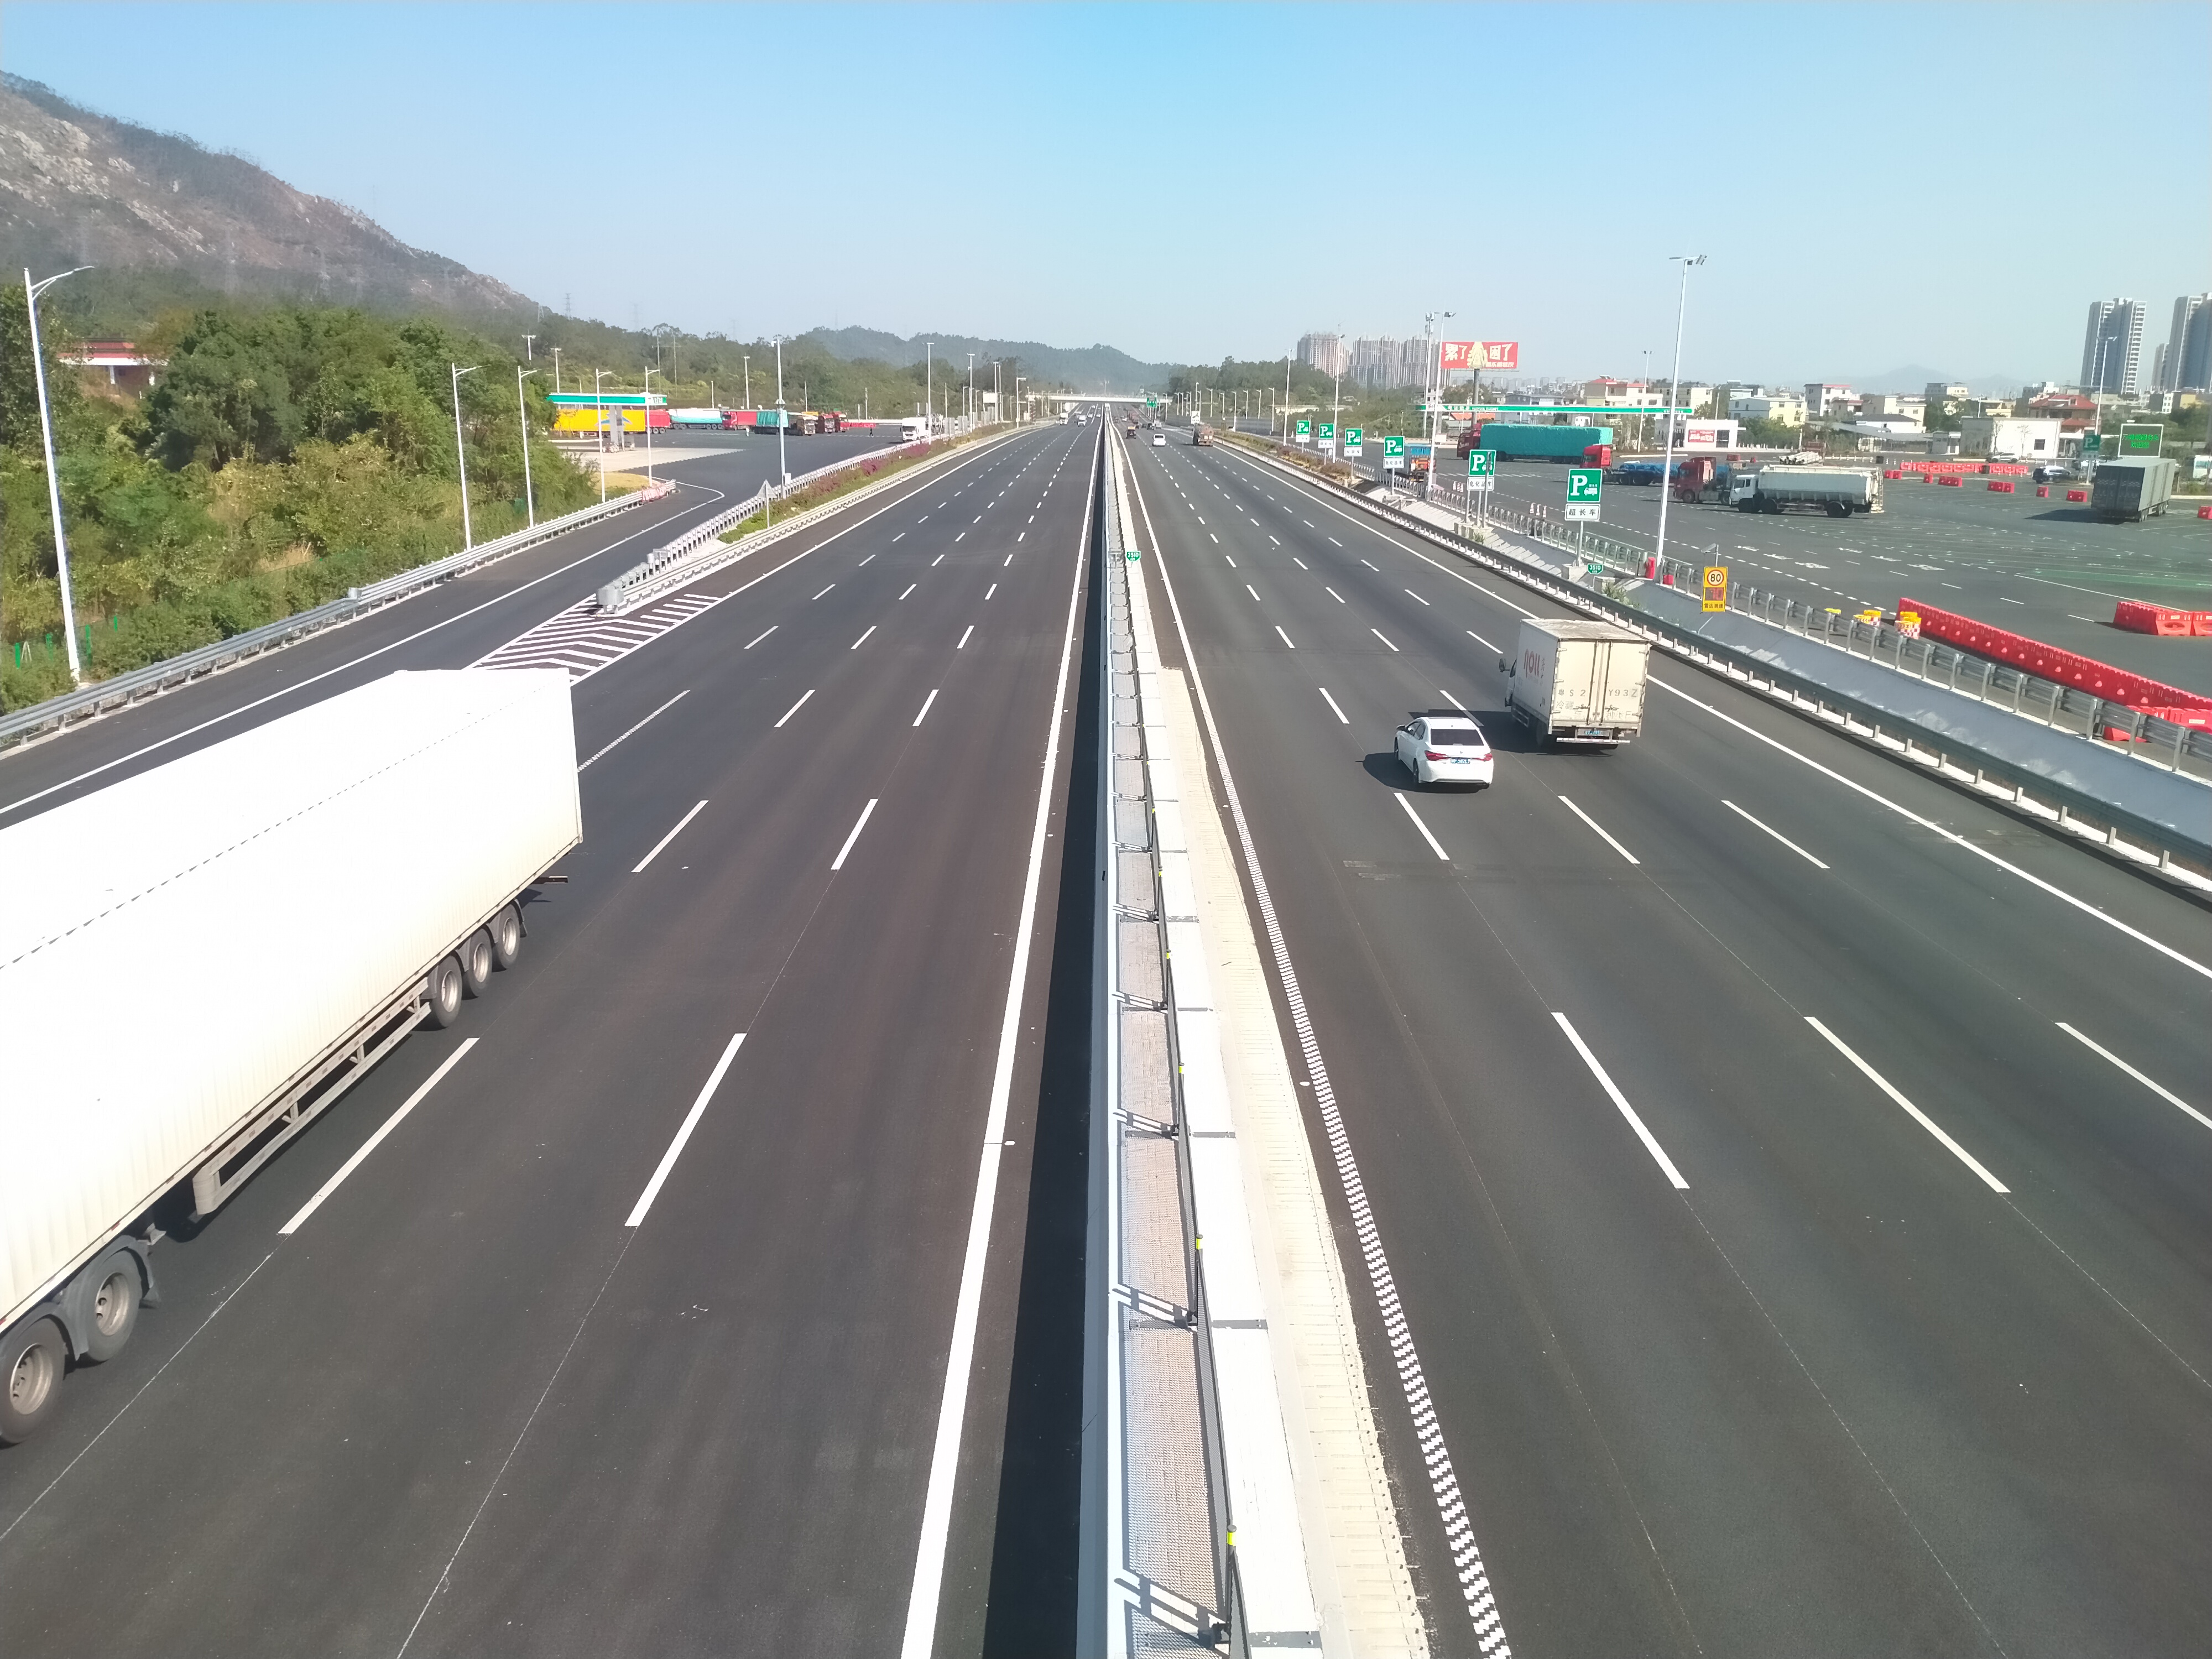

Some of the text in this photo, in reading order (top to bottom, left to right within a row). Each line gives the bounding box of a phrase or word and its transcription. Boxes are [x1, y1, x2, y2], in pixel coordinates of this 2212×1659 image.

[1444, 343, 1513, 361] 累了 困了
[1298, 422, 1305, 432] P
[1320, 426, 1328, 436] P
[1346, 431, 1355, 444] P
[2084, 437, 2093, 448] P
[1386, 440, 1396, 453] P
[1471, 455, 1485, 471] P
[1571, 475, 1587, 495] P
[1710, 573, 1721, 582] 80
